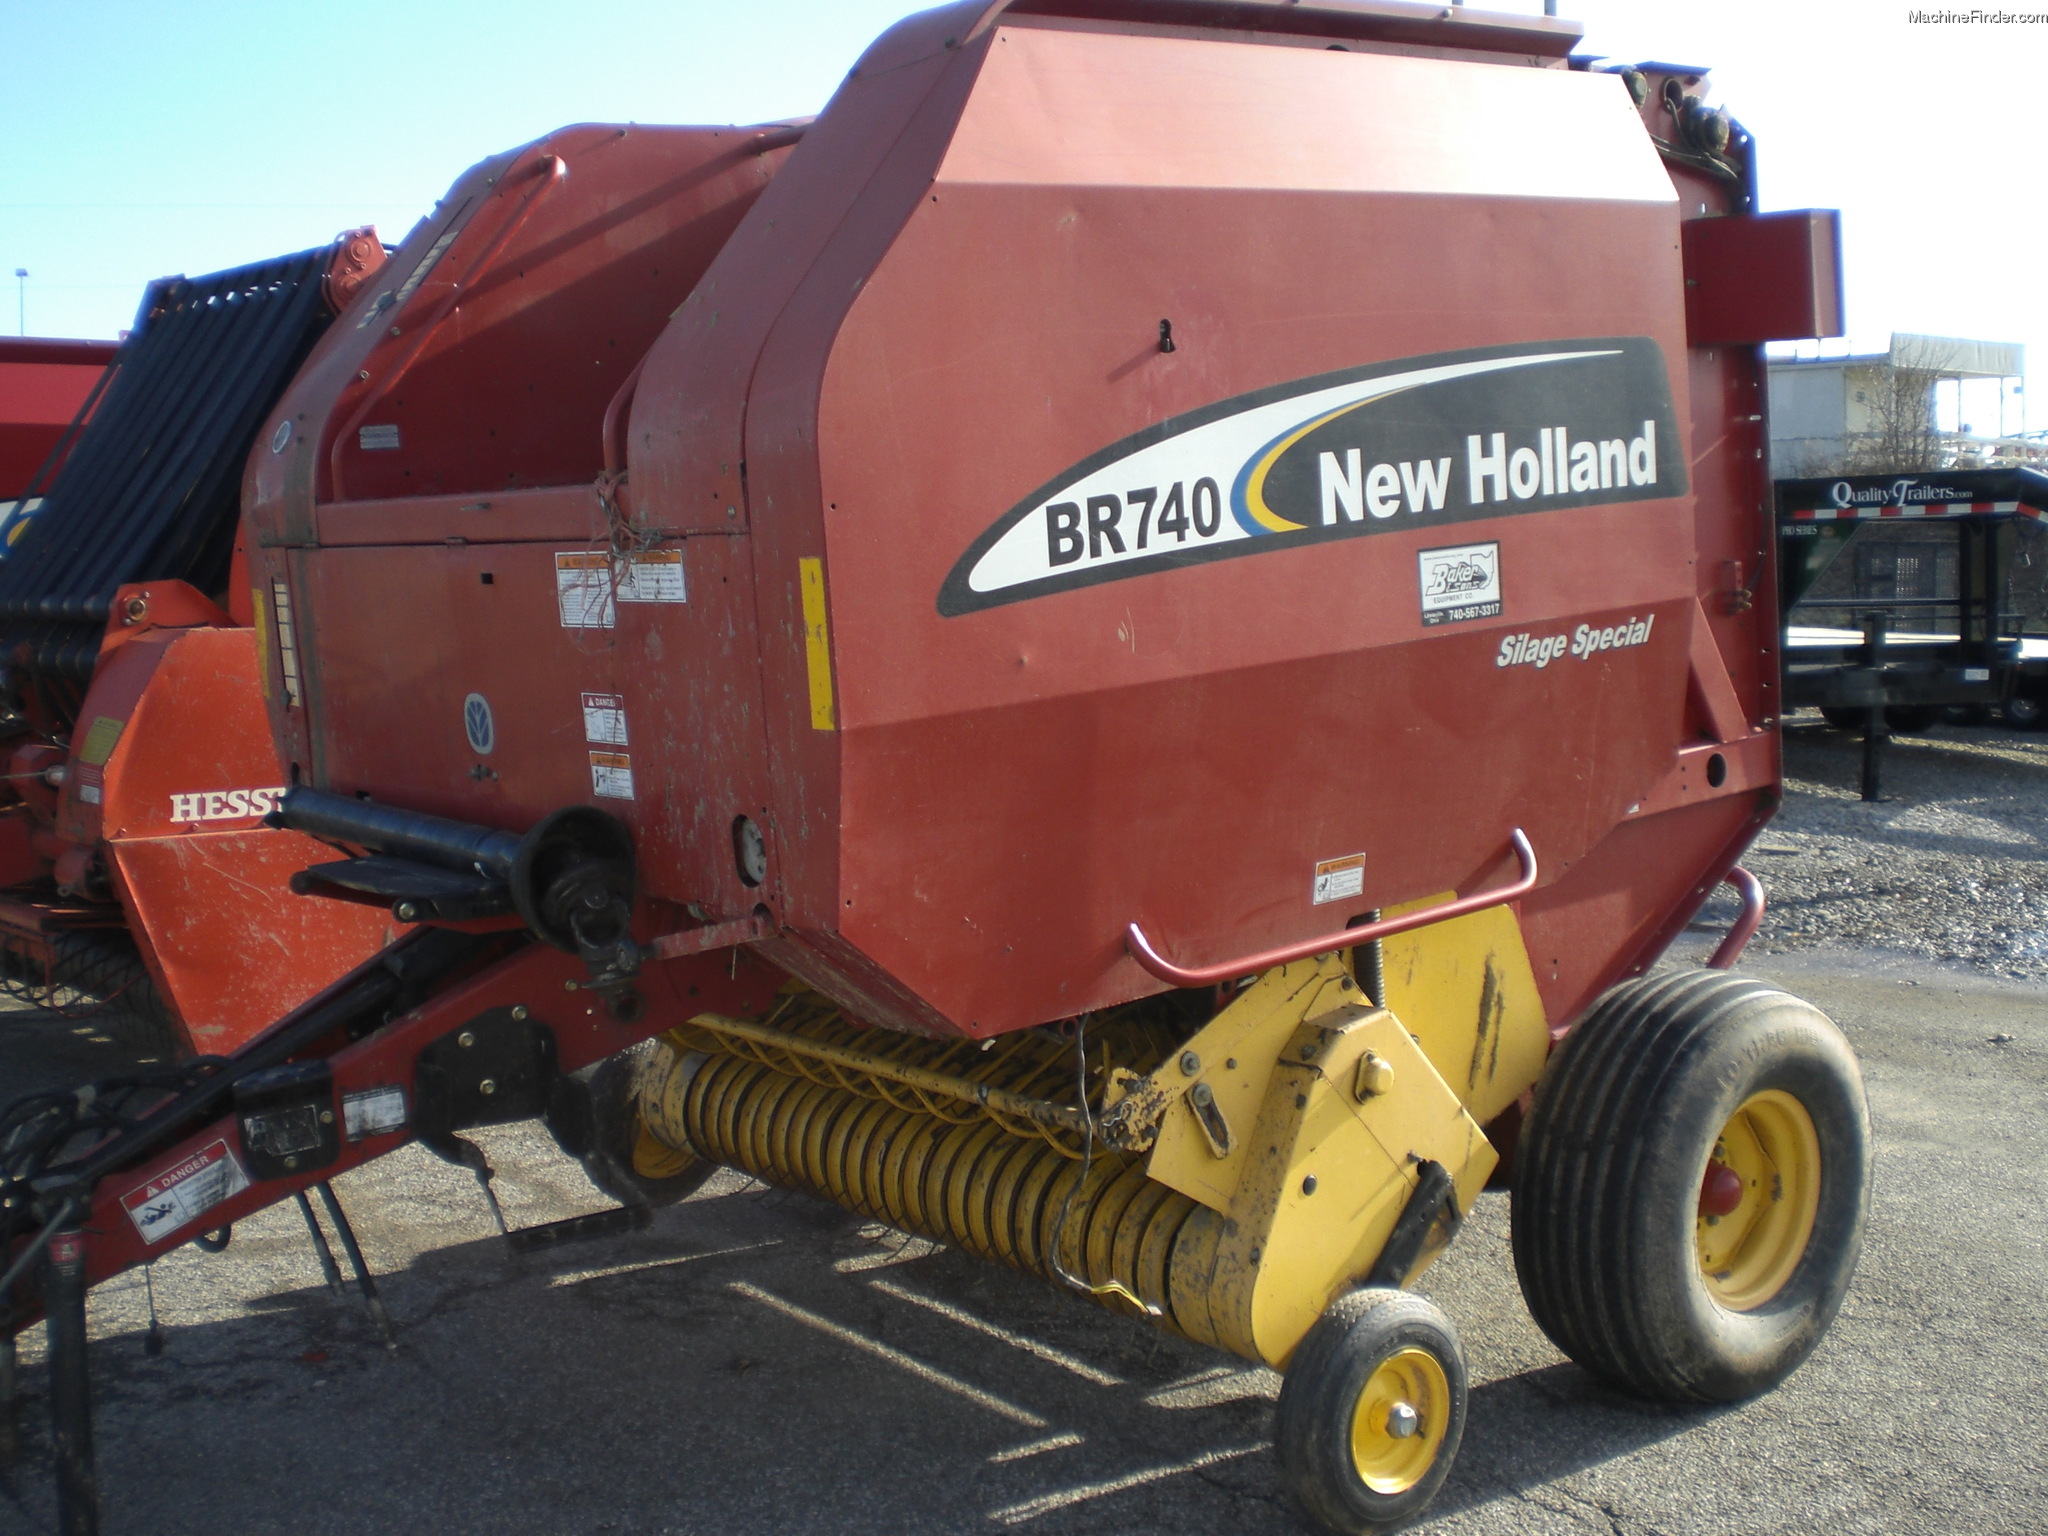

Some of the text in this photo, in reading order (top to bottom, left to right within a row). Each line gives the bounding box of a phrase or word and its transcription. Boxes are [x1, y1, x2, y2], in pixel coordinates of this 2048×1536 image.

[1319, 419, 1657, 526] New Holland
[1045, 476, 1222, 567] BR740
[1425, 561, 1480, 597] Baker
[1448, 603, 1500, 620] 740-567-3317
[1496, 613, 1656, 669] Silage Special
[161, 1155, 209, 1187] DANGER
